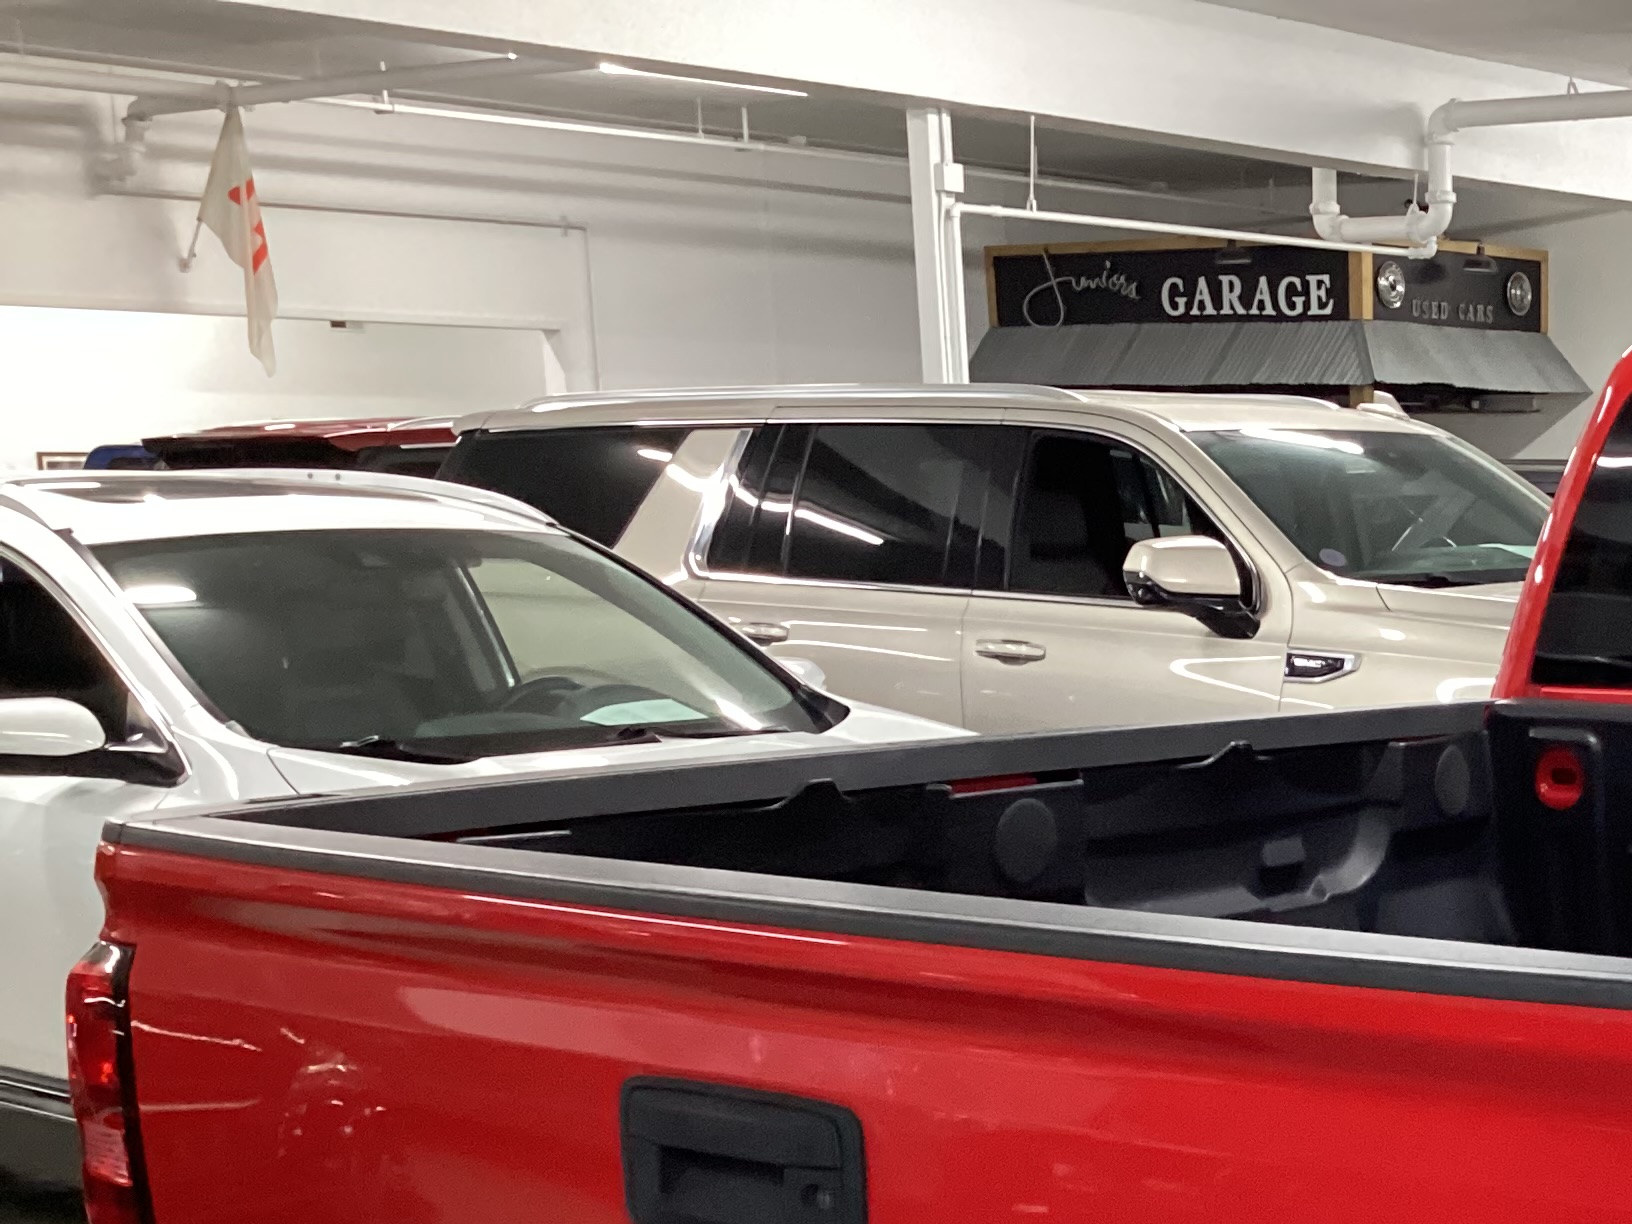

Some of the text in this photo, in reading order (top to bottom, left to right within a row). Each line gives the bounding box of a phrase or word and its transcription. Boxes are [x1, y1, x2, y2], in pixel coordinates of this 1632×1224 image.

[1160, 274, 1334, 317] GARAGE
[1412, 299, 1494, 324] USED CARS
